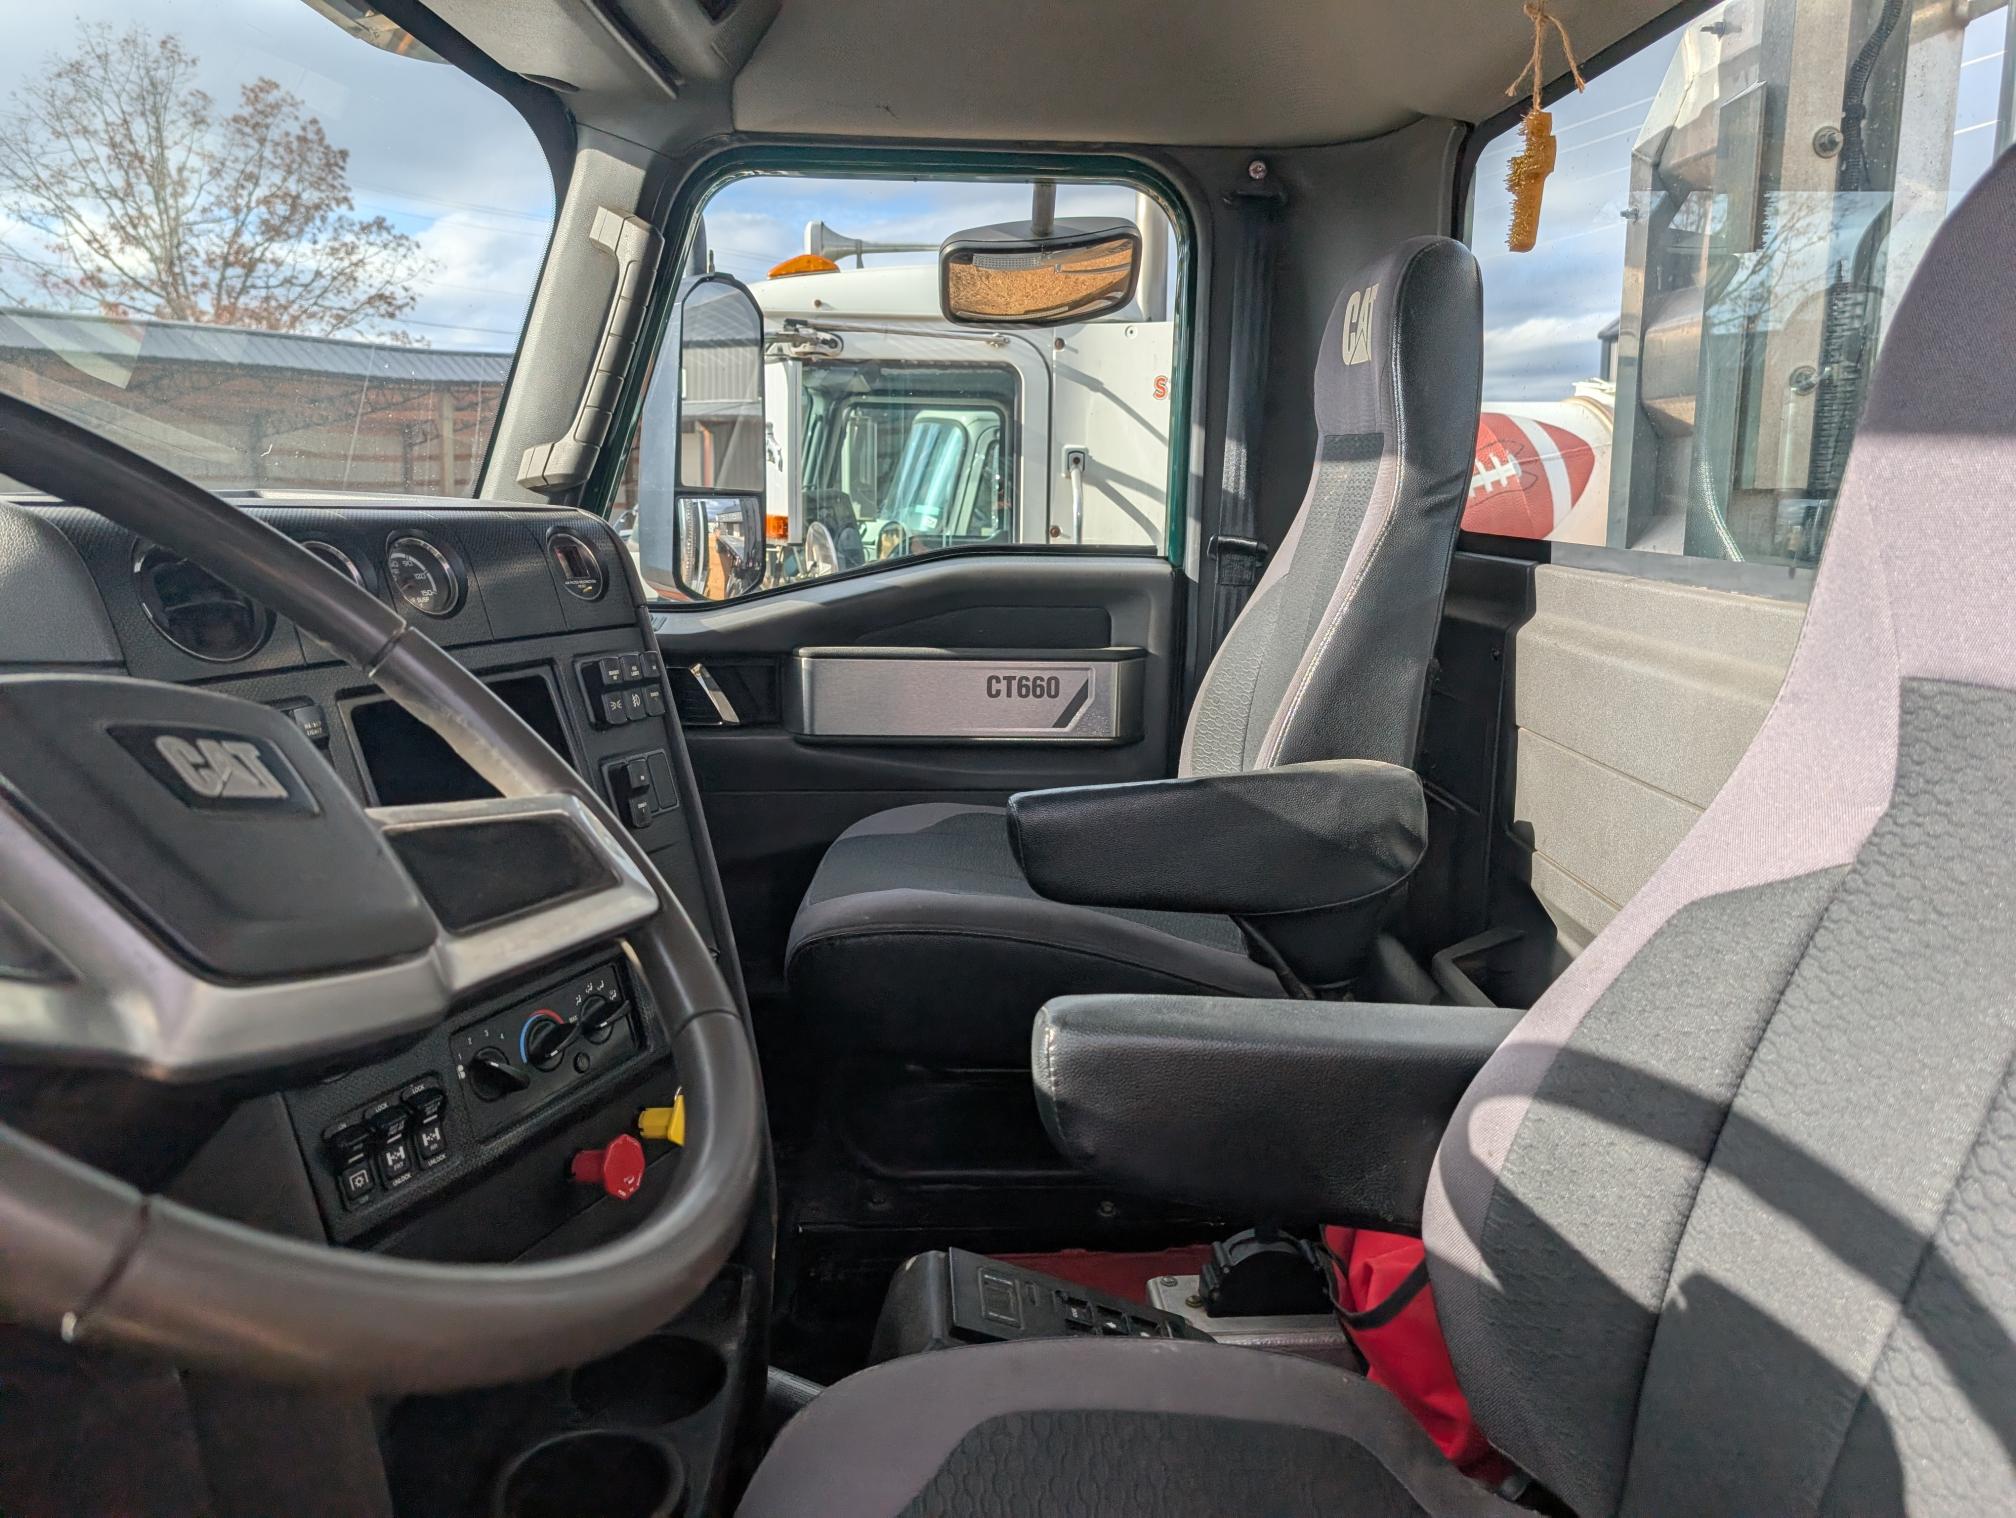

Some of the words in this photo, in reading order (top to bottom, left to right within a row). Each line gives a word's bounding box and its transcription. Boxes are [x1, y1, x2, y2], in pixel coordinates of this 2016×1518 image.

[1341, 282, 1380, 366] CAT
[420, 589, 433, 597] 150
[986, 675, 1060, 699] CT660
[156, 735, 288, 799] CAT
[411, 1084, 426, 1095] LOCK
[375, 1102, 389, 1113] LOCK
[427, 1153, 447, 1167] UNLOCK
[392, 1173, 411, 1186] UNLOCK
